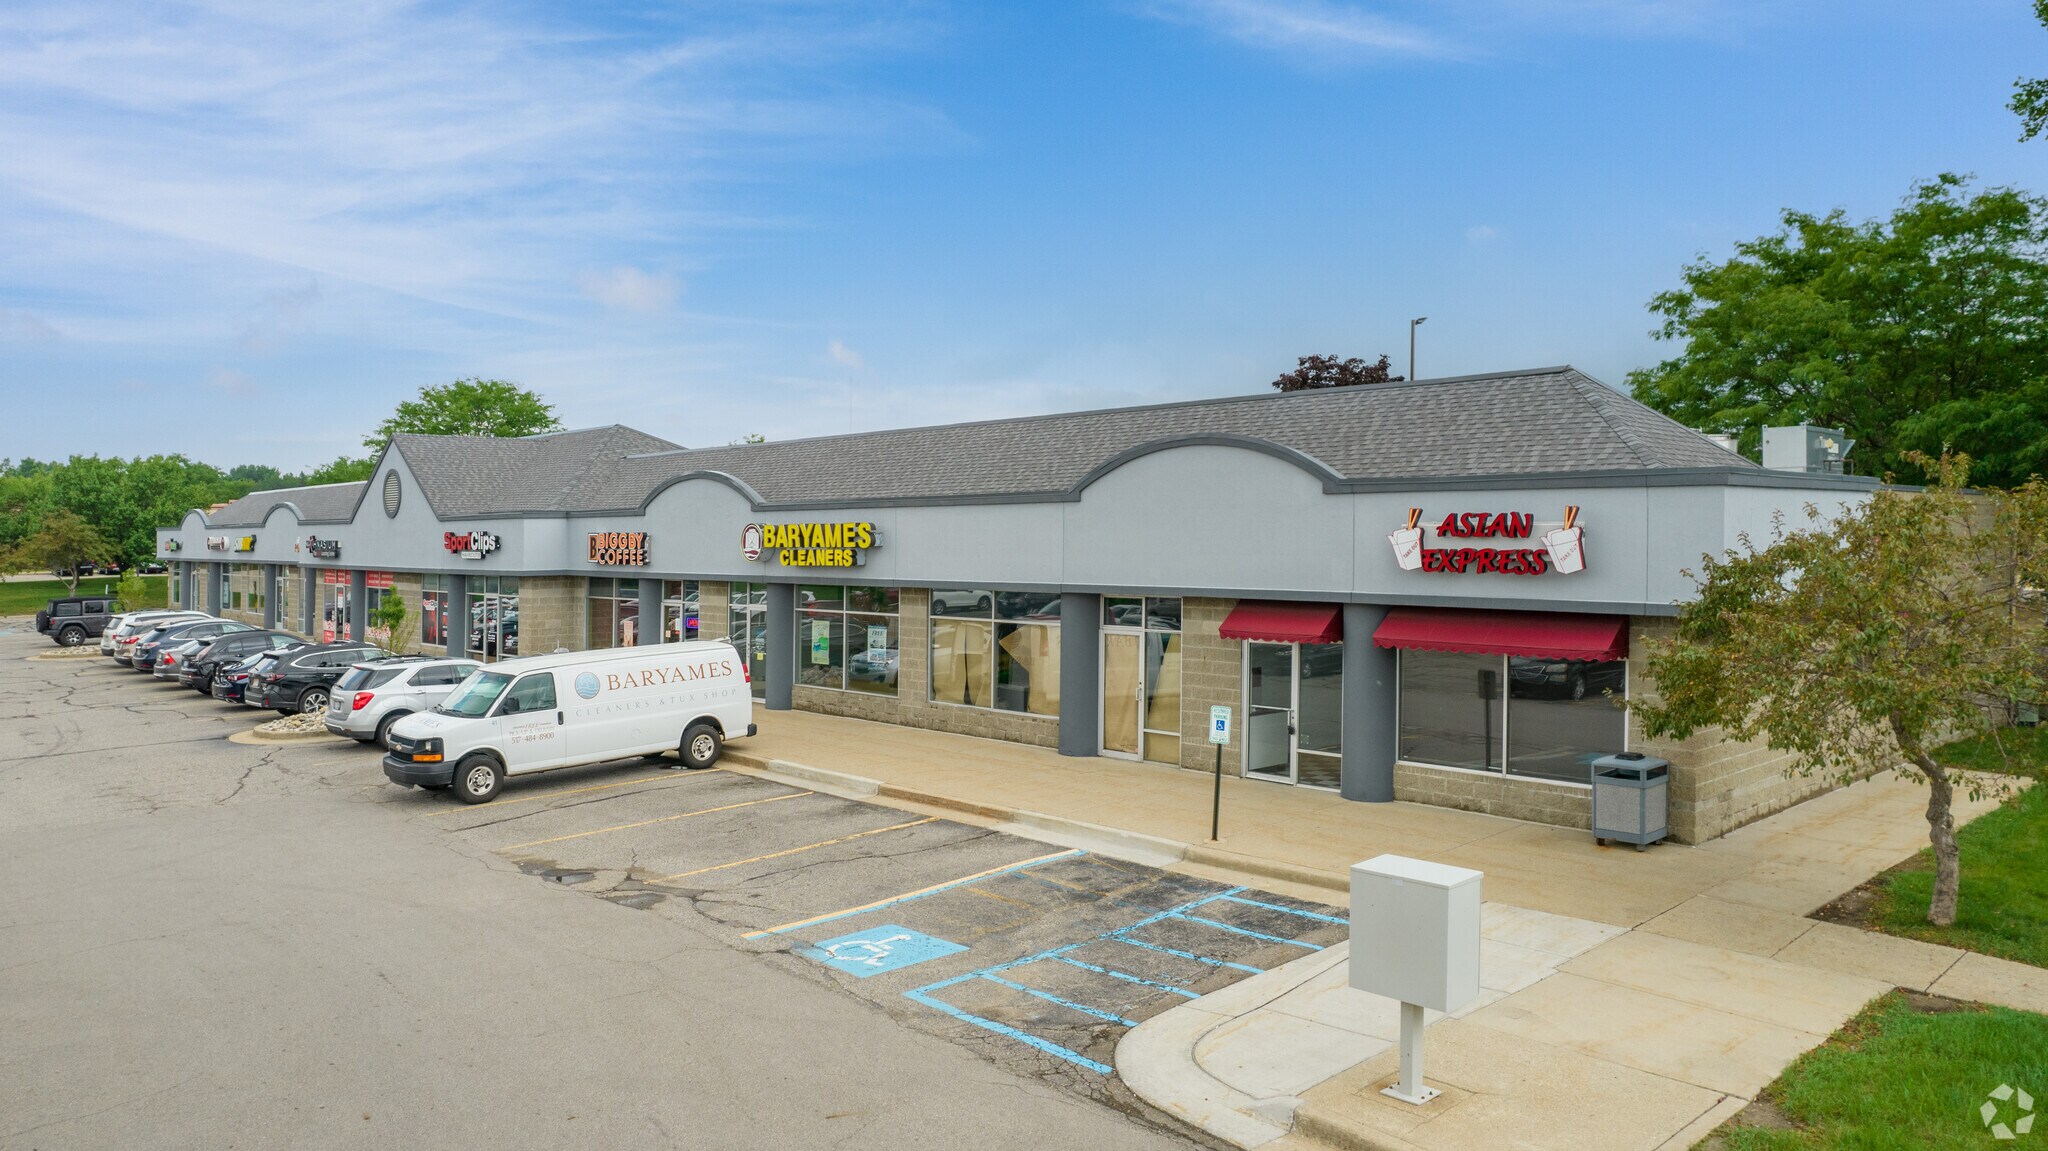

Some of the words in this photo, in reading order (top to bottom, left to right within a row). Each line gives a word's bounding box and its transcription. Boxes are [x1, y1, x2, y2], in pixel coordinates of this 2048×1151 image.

[763, 522, 872, 549] BARYAMES
[1436, 511, 1531, 538] ASIAN
[598, 532, 643, 549] BIGGBY
[598, 549, 643, 565] COFFEE
[780, 549, 853, 567] CLEANERS
[1421, 547, 1549, 575] EXPRESS
[606, 660, 733, 691] BARYAMES
[575, 701, 650, 718] CLEANERS
[670, 694, 695, 704] TUX
[703, 688, 738, 700] SHOP
